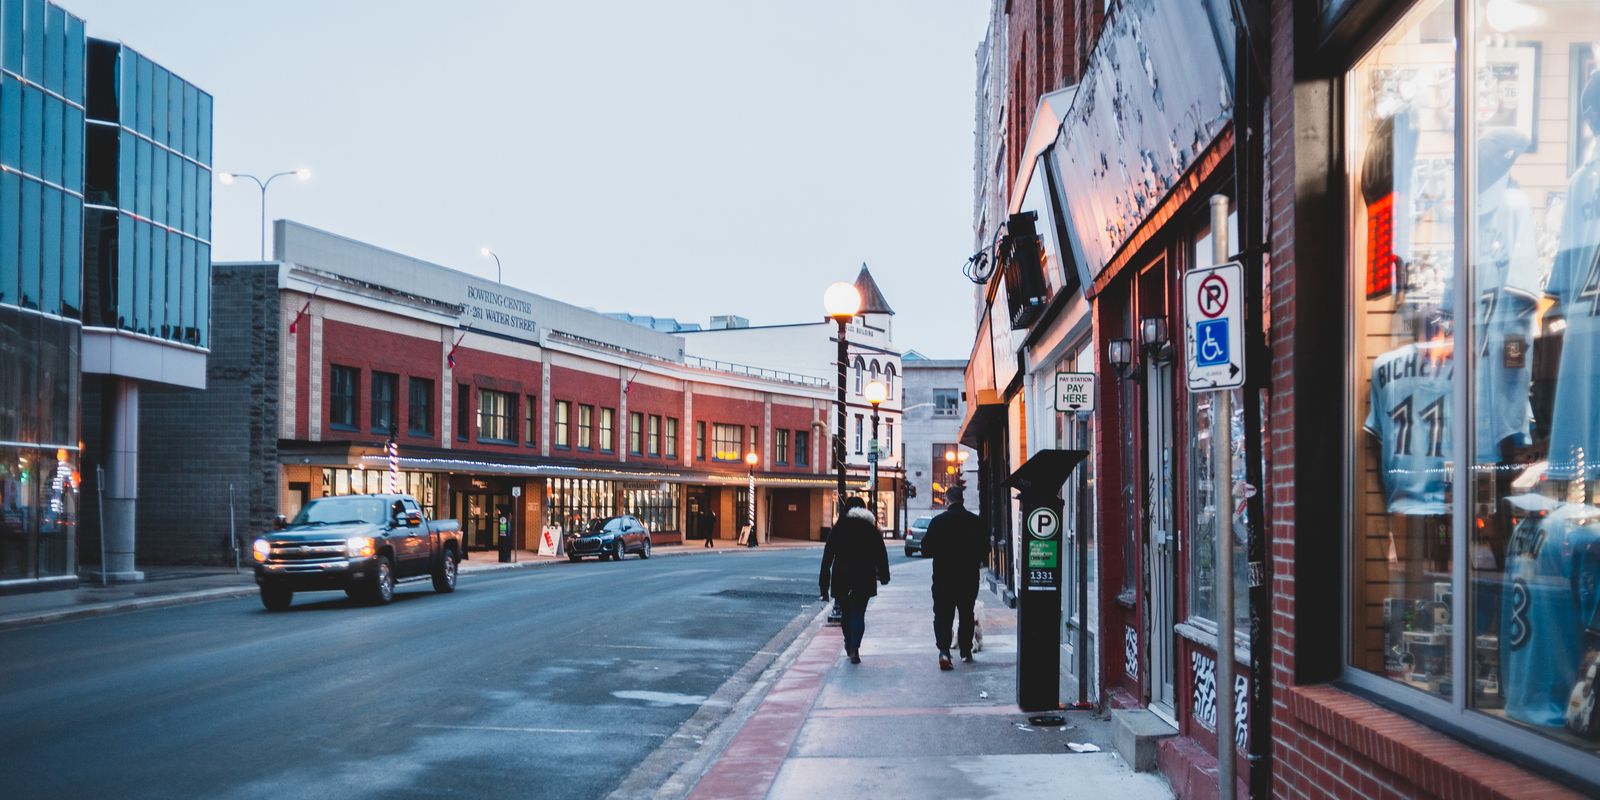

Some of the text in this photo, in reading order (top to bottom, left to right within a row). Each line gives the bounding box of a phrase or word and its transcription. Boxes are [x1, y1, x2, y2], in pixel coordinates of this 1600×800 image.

[467, 286, 532, 315] BOWRING CENTRE
[485, 309, 510, 327] WATER
[510, 316, 536, 332] STREET
[1067, 384, 1084, 393] PAY
[1063, 394, 1087, 403] HERE
[1387, 392, 1446, 457] 11
[1030, 571, 1053, 580] 1331
